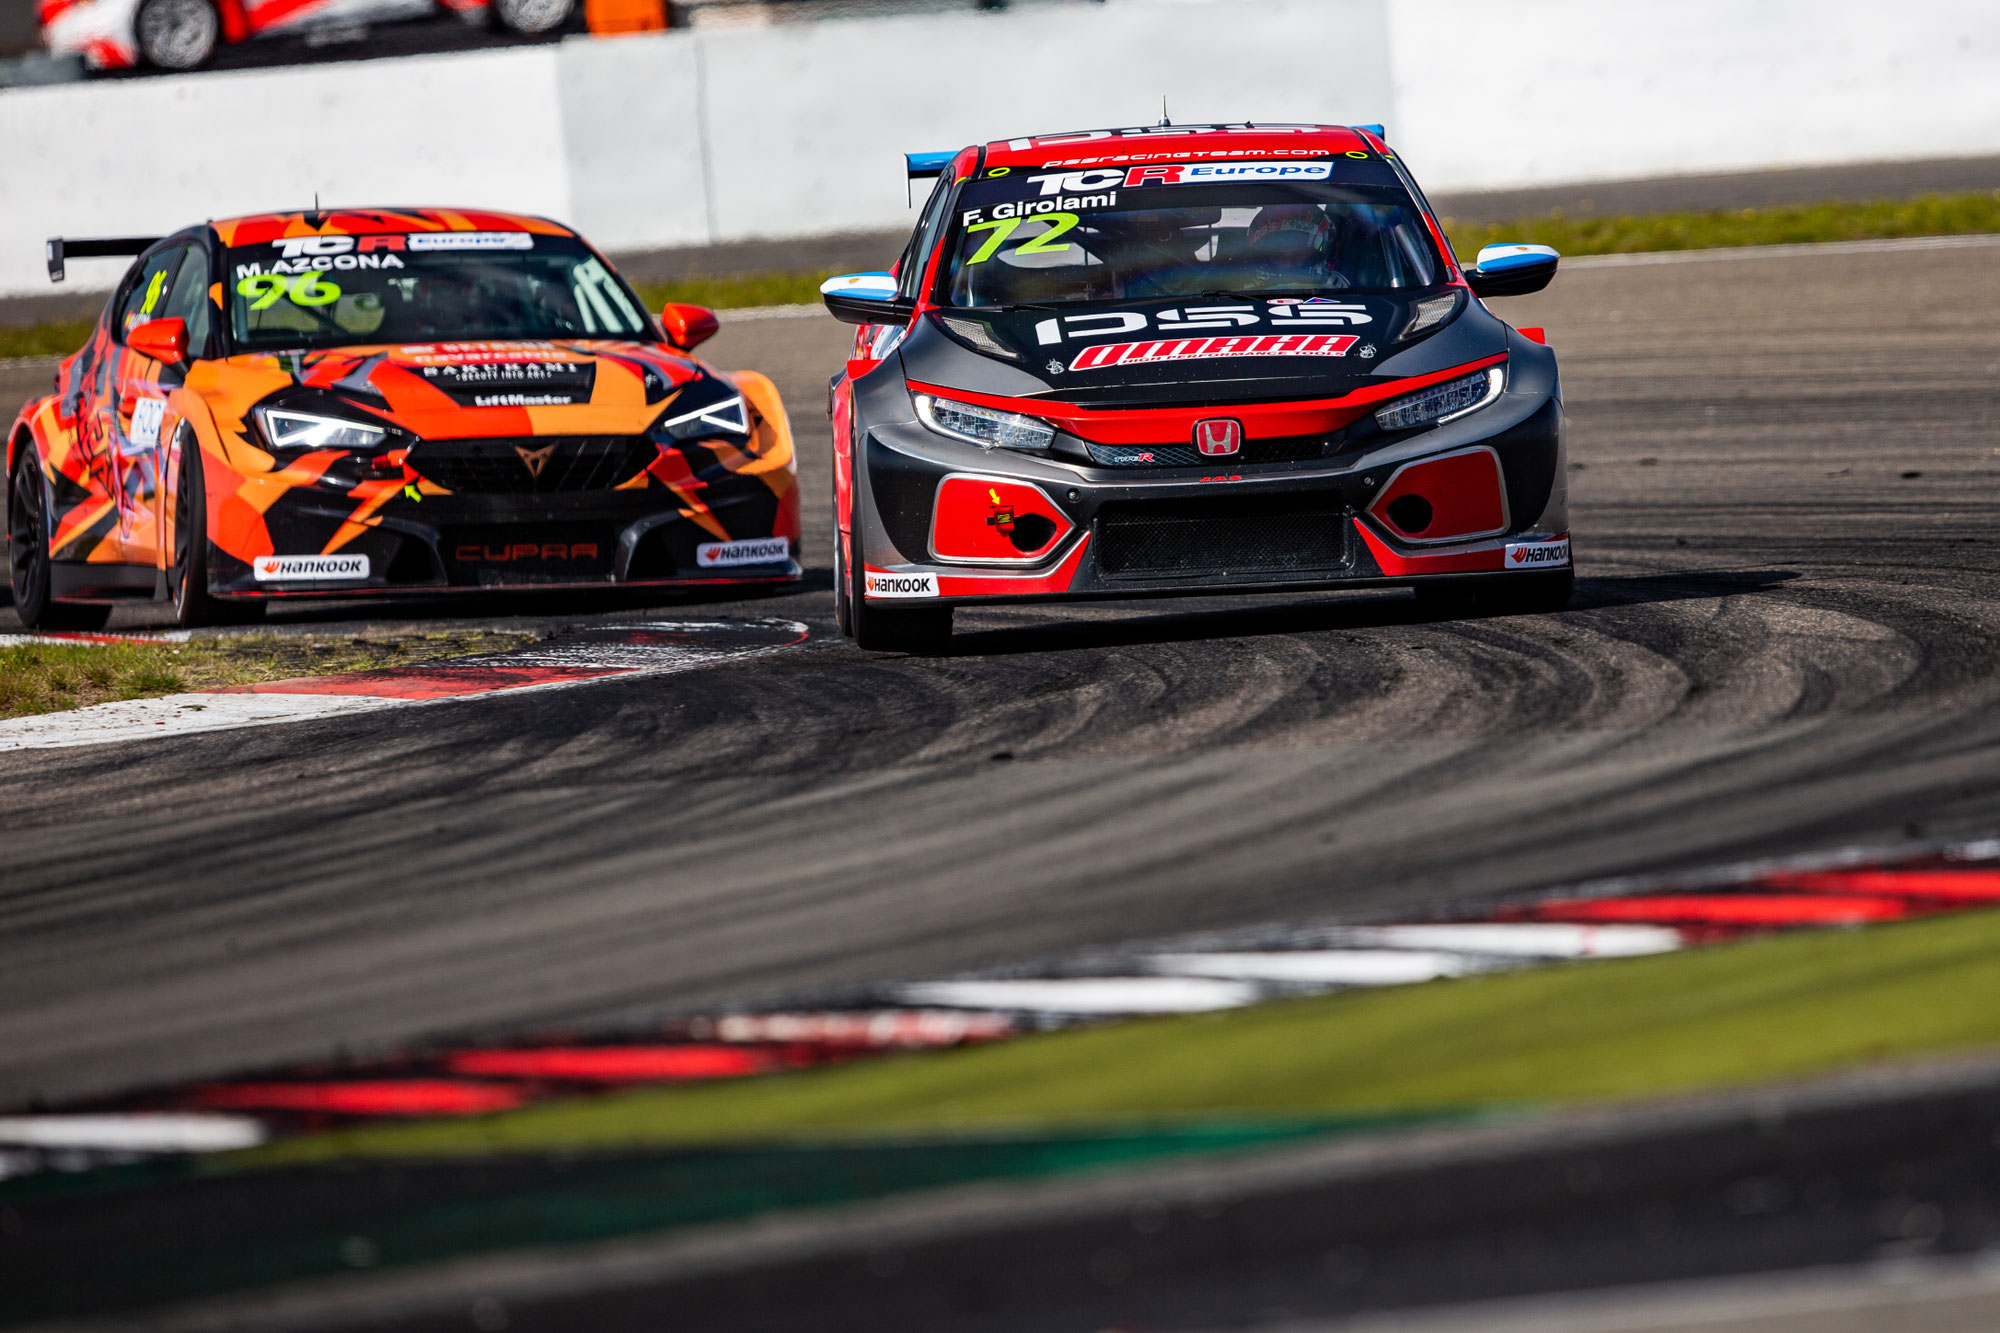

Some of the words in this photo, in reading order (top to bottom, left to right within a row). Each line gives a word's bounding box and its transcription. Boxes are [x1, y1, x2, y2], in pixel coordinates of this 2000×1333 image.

[1027, 165, 1186, 196] TCR
[1191, 166, 1327, 177] Europe
[963, 209, 984, 226] F.
[992, 191, 1116, 218] Girolami
[272, 235, 406, 258] TCR
[966, 212, 1080, 265] 72
[236, 254, 405, 280] M.AZCONA
[237, 271, 341, 310] 96
[456, 543, 598, 560] CUPRA
